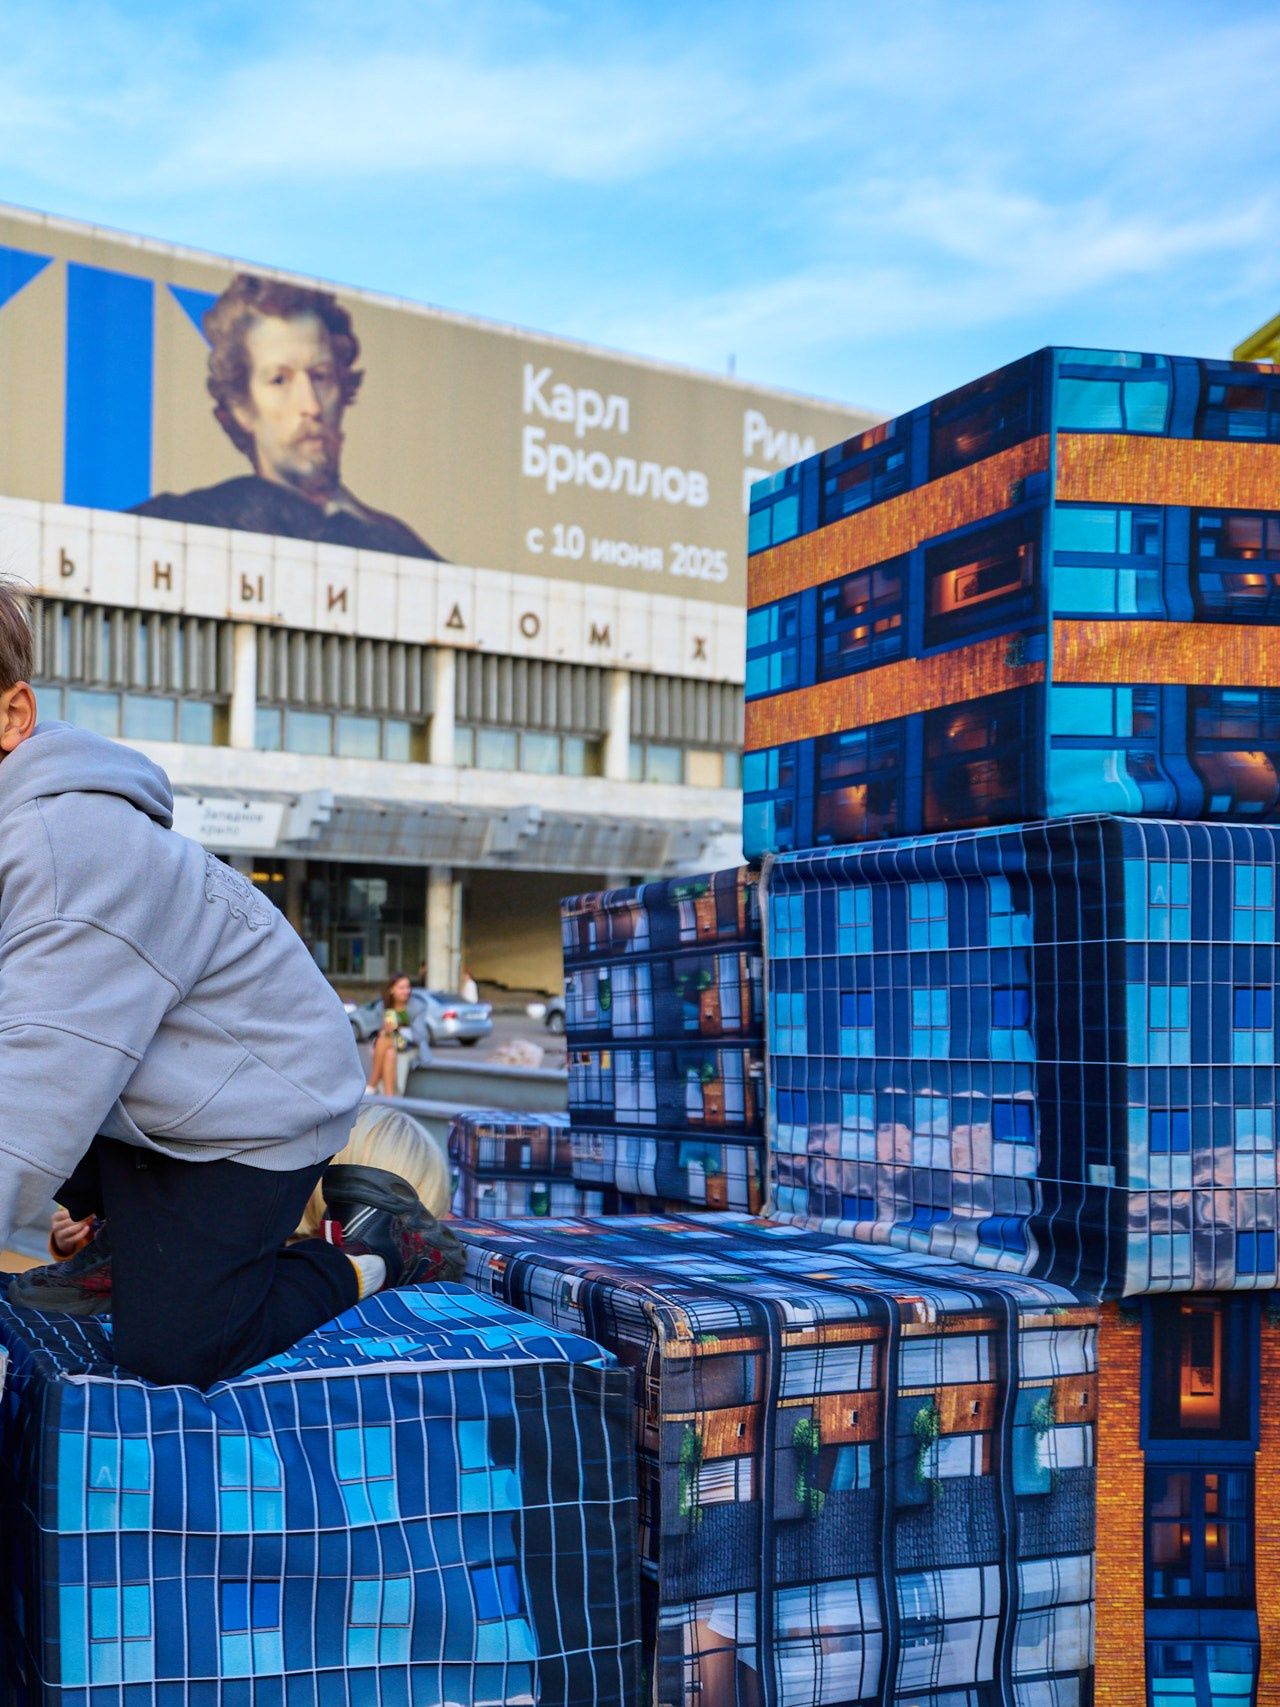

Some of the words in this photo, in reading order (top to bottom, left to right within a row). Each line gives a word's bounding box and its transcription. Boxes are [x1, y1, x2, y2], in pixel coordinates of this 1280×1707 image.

[522, 362, 630, 439] Карл
[522, 425, 710, 508] Брюллов
[743, 408, 818, 466] Рим
[524, 527, 545, 554] с
[551, 523, 585, 561] 10
[590, 536, 664, 572] июня
[668, 541, 729, 582] 2025
